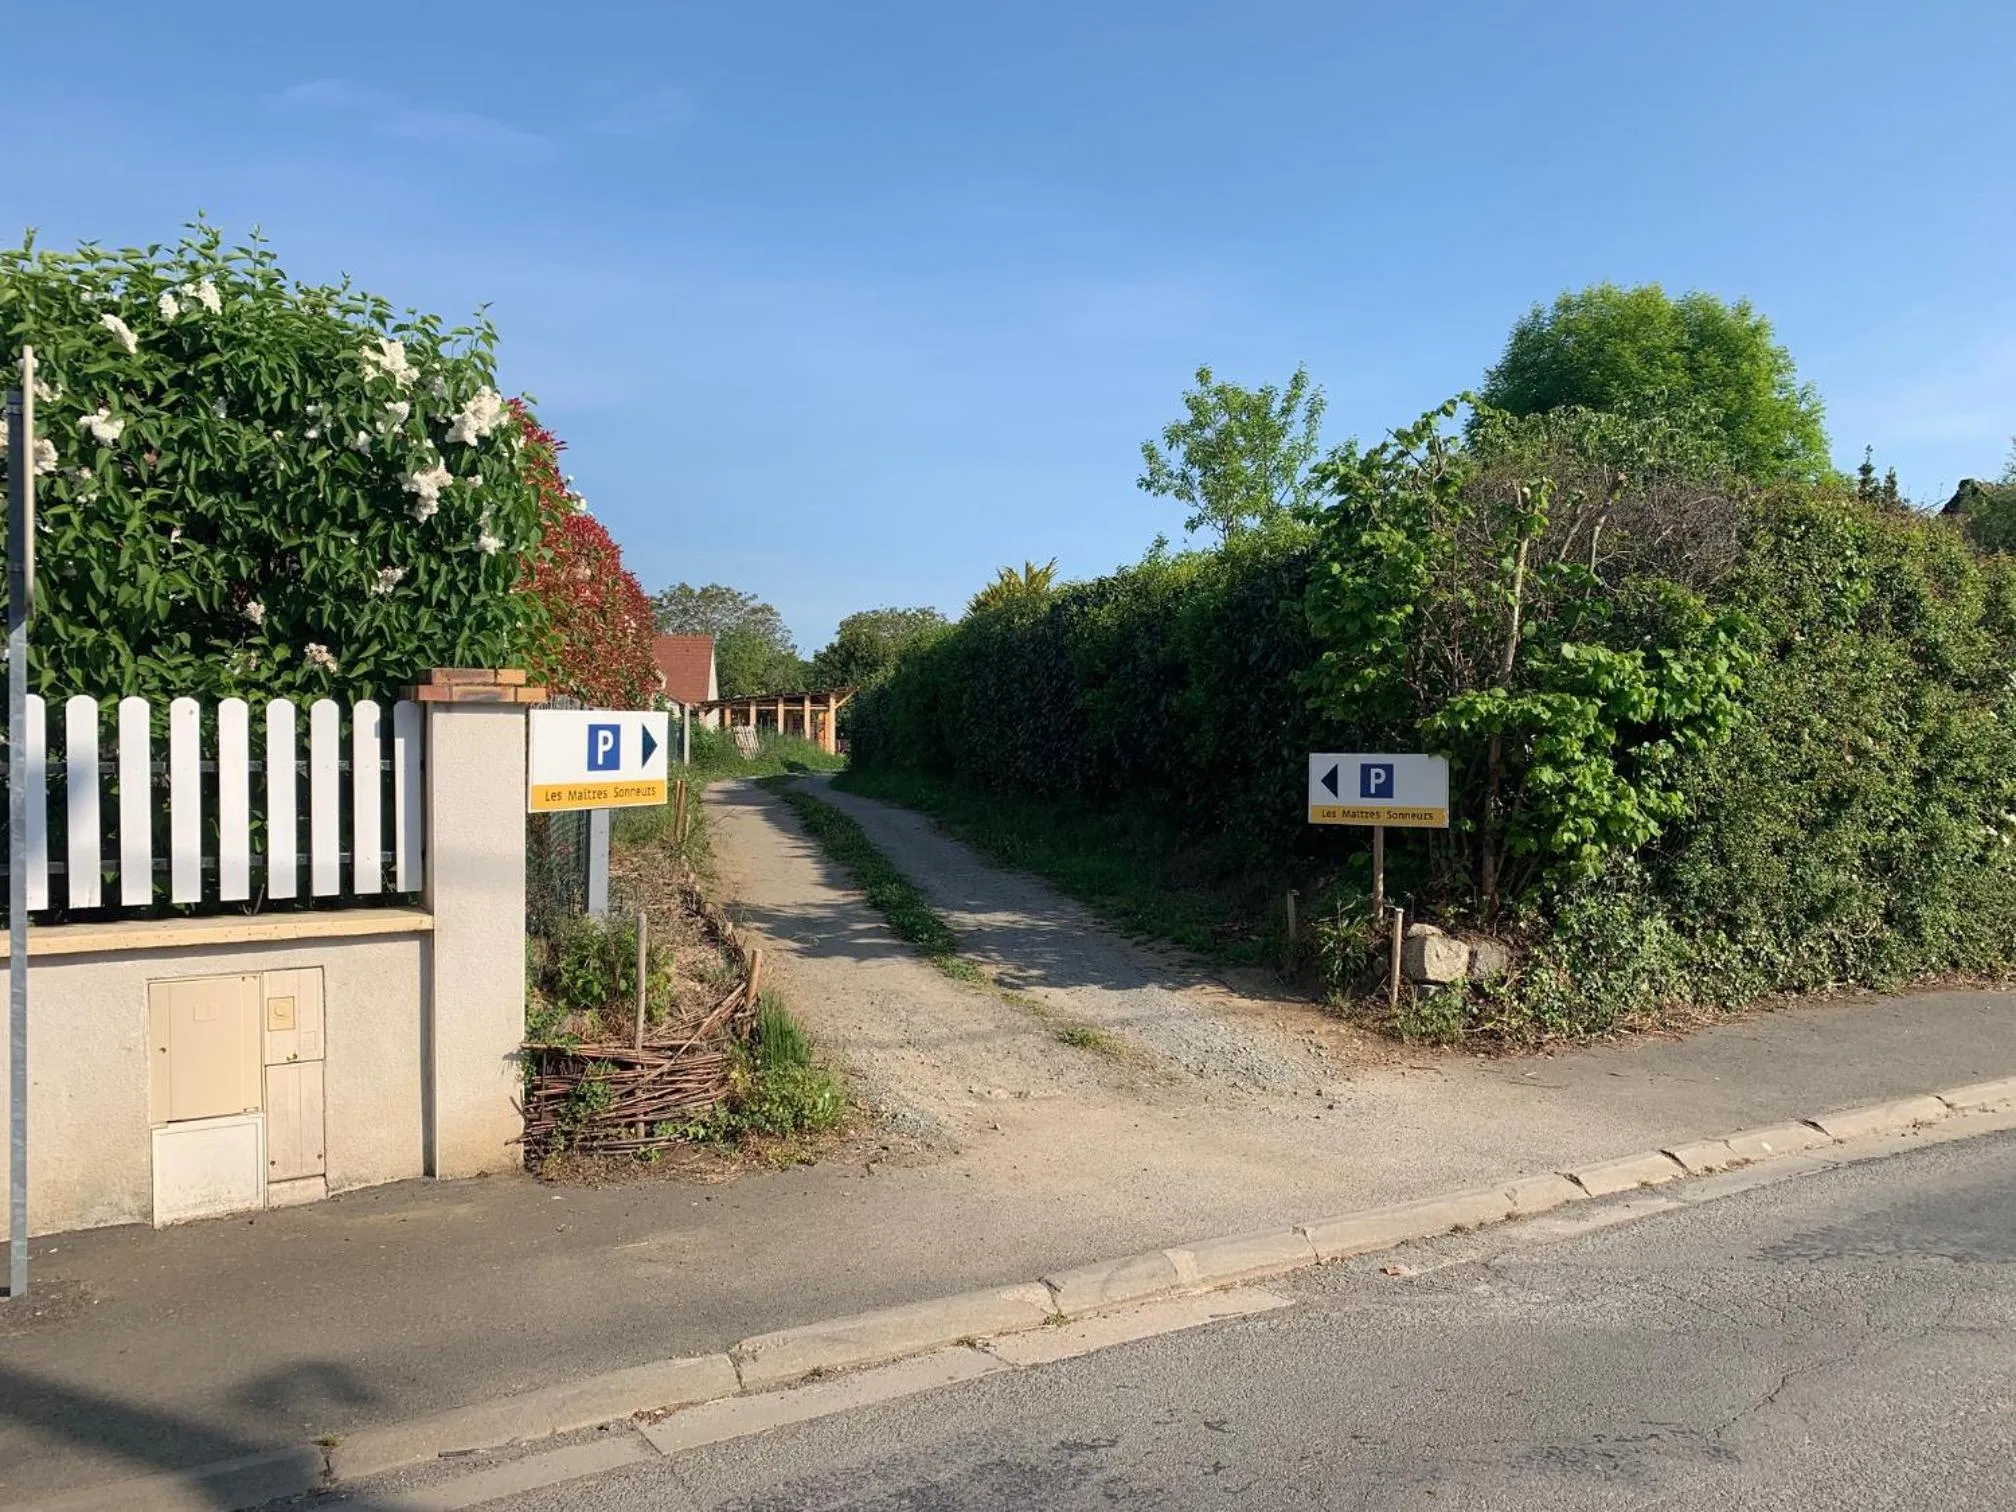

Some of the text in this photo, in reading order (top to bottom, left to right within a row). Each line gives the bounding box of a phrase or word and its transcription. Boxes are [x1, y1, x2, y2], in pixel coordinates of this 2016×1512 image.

[597, 730, 614, 766] P
[1370, 768, 1386, 794] P
[545, 790, 563, 802] Les
[614, 786, 657, 798] Sonneurs
[1322, 809, 1337, 818] Les
[1387, 810, 1434, 821] Sonneurs
